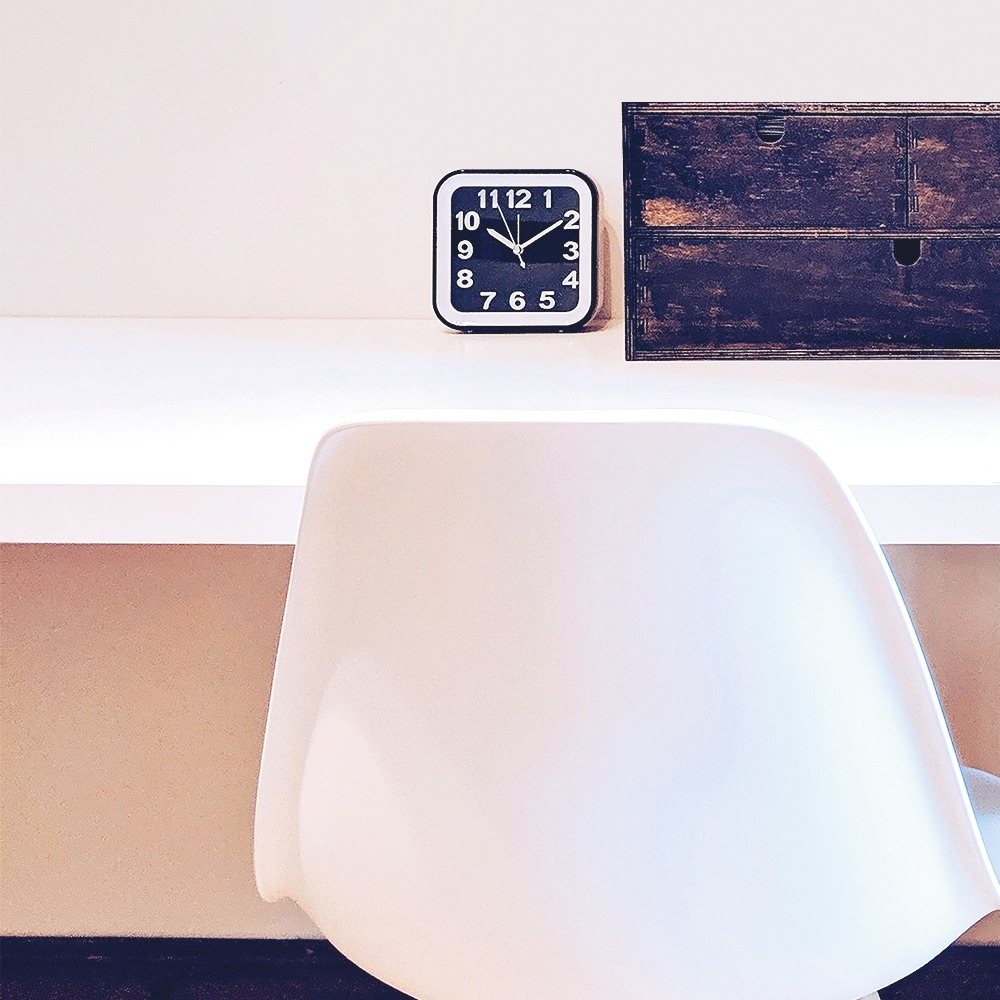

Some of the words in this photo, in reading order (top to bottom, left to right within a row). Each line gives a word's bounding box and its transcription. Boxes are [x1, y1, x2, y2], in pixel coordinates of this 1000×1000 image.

[478, 189, 498, 208] 11
[506, 189, 531, 208] 12
[543, 189, 552, 208] 1
[456, 211, 480, 230] 10
[563, 210, 580, 229] 2
[457, 240, 473, 260] 9
[562, 241, 579, 260] 3
[456, 269, 473, 288] 8
[562, 270, 579, 289] 4
[480, 291, 496, 310] 7
[509, 291, 526, 310] 6
[539, 291, 555, 309] 5
